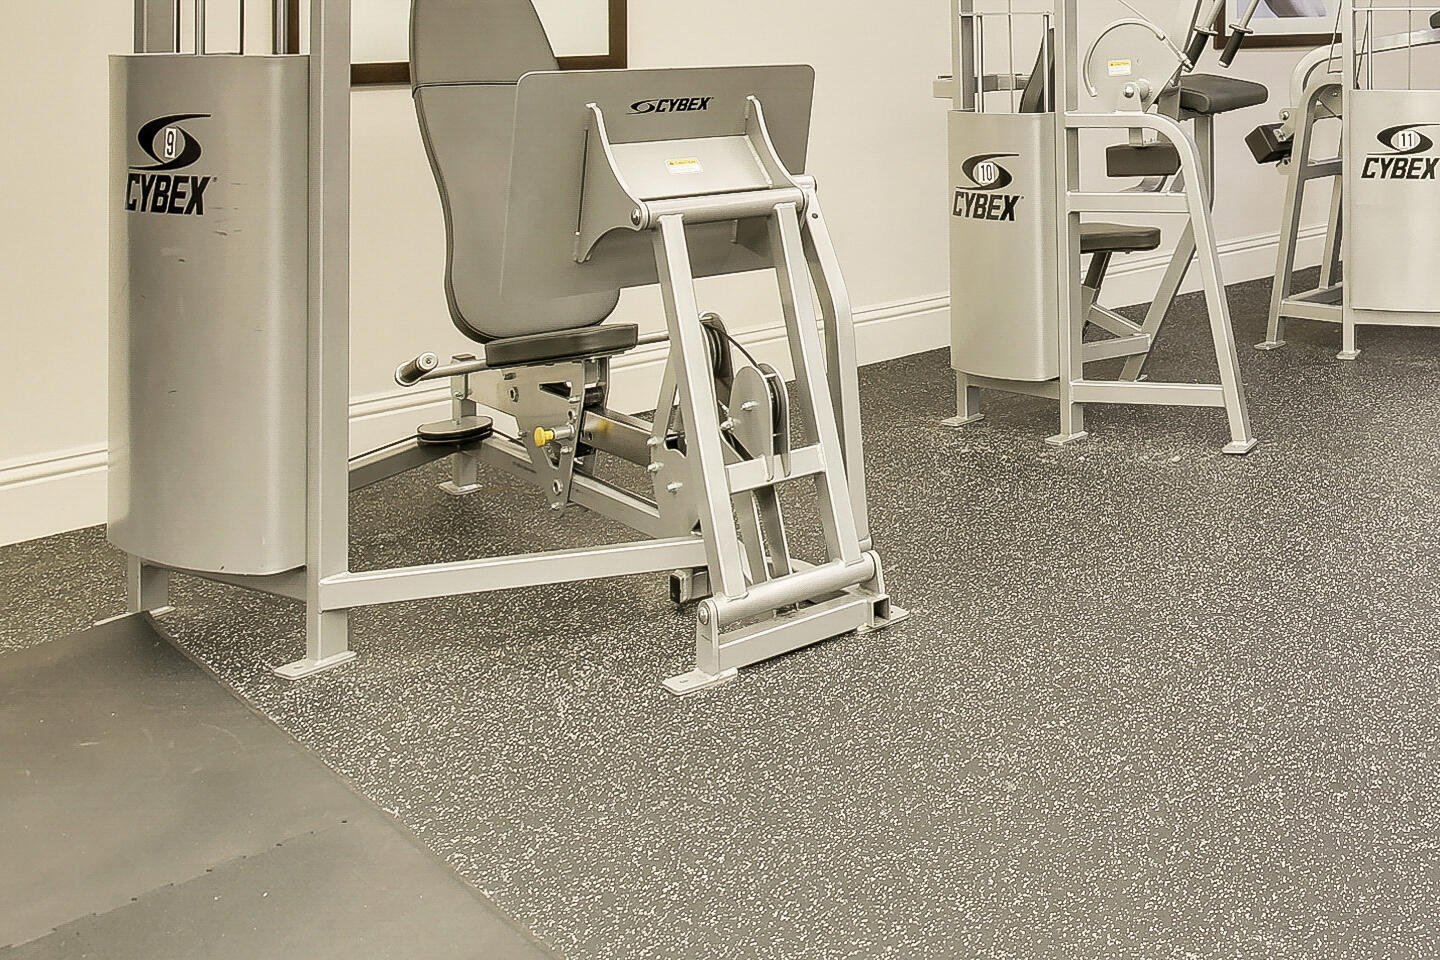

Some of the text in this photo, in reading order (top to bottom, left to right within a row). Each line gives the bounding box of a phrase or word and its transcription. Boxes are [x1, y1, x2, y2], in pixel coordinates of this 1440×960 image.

[655, 97, 712, 113] CYBEX
[166, 130, 175, 156] 9
[1401, 133, 1413, 147] 11
[980, 164, 993, 181] 10
[1361, 157, 1440, 180] CYBEX
[125, 173, 211, 215] CYBEX
[952, 190, 1020, 221] CYBEX
